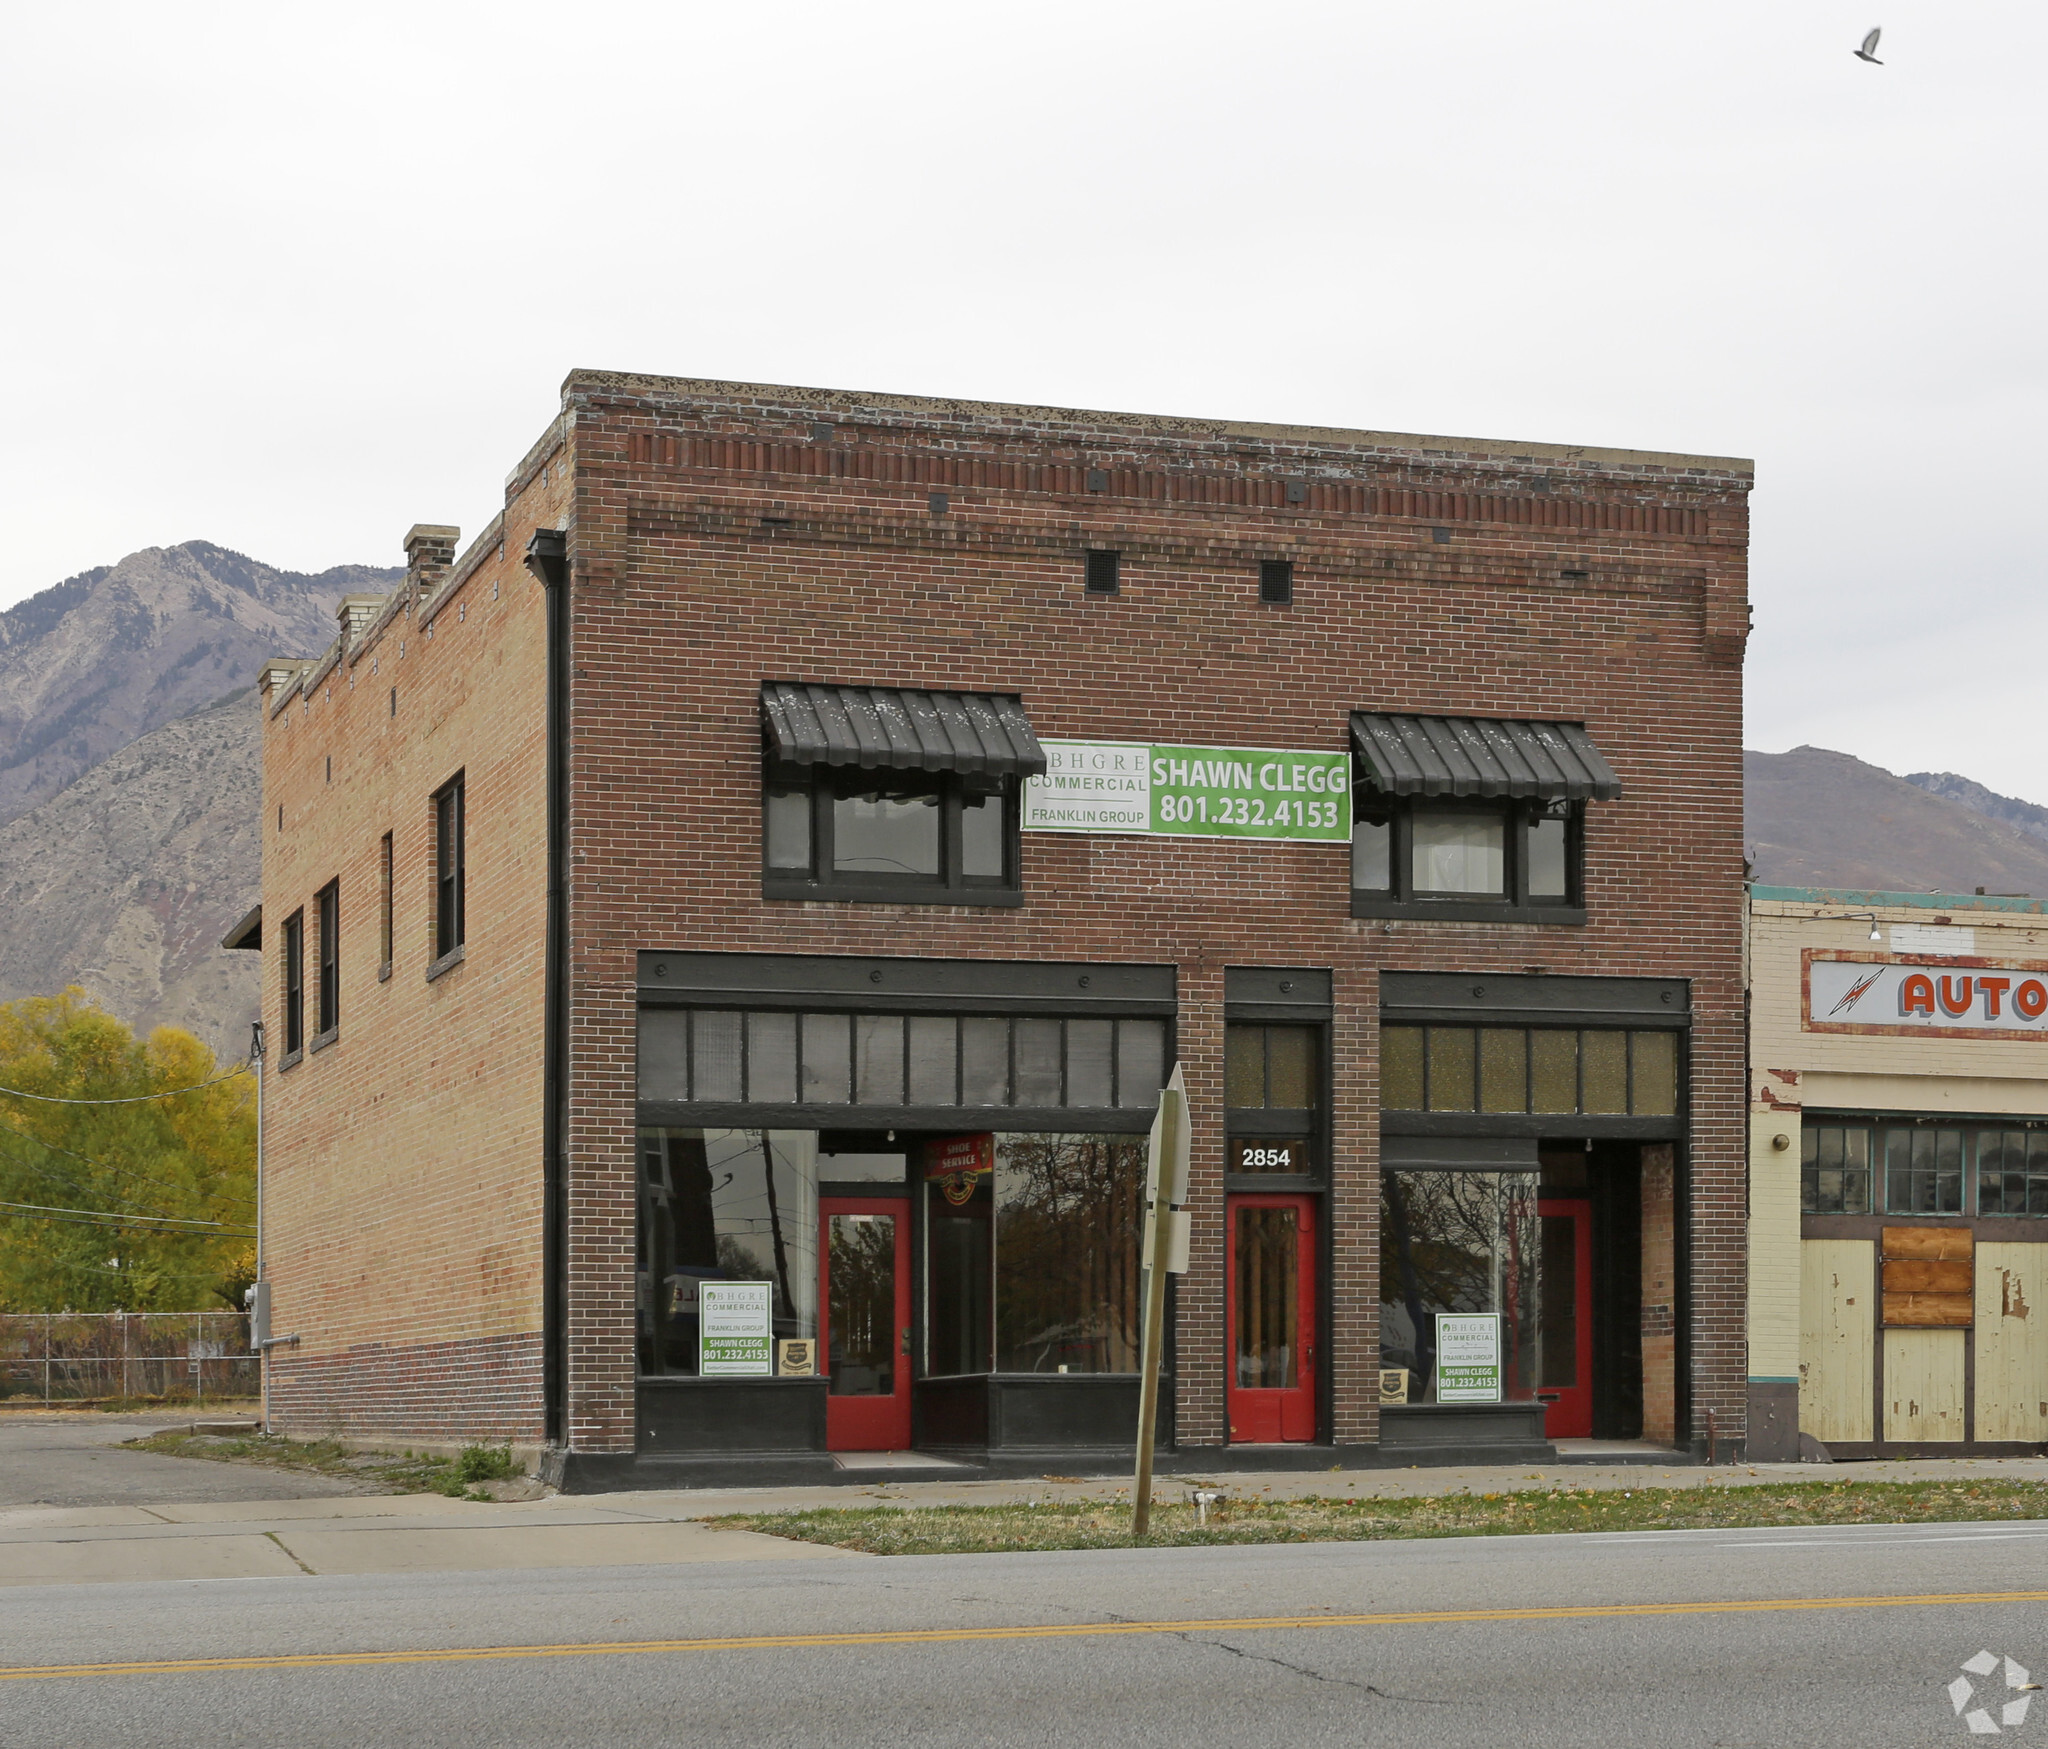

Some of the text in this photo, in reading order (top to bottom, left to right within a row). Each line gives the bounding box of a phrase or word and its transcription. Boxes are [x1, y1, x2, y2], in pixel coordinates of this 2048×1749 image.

[1152, 758, 1347, 793] SHAWN CLEGG
[1030, 775, 1147, 791] COMMERCIAL
[1032, 809, 1144, 823] FRANKLIN GROUP
[1159, 795, 1338, 828] 801.232.4153
[1898, 973, 2048, 1022] AUTO
[947, 1143, 971, 1155] SHOE
[942, 1155, 976, 1168] SERVICE
[1242, 1149, 1291, 1166] 2854
[709, 1339, 763, 1347] SHAWN CLEGG
[704, 1349, 768, 1359] 801.232.4153
[1445, 1367, 1492, 1376] SHAWN CLEGG
[1440, 1377, 1497, 1387] 801.232.4153
